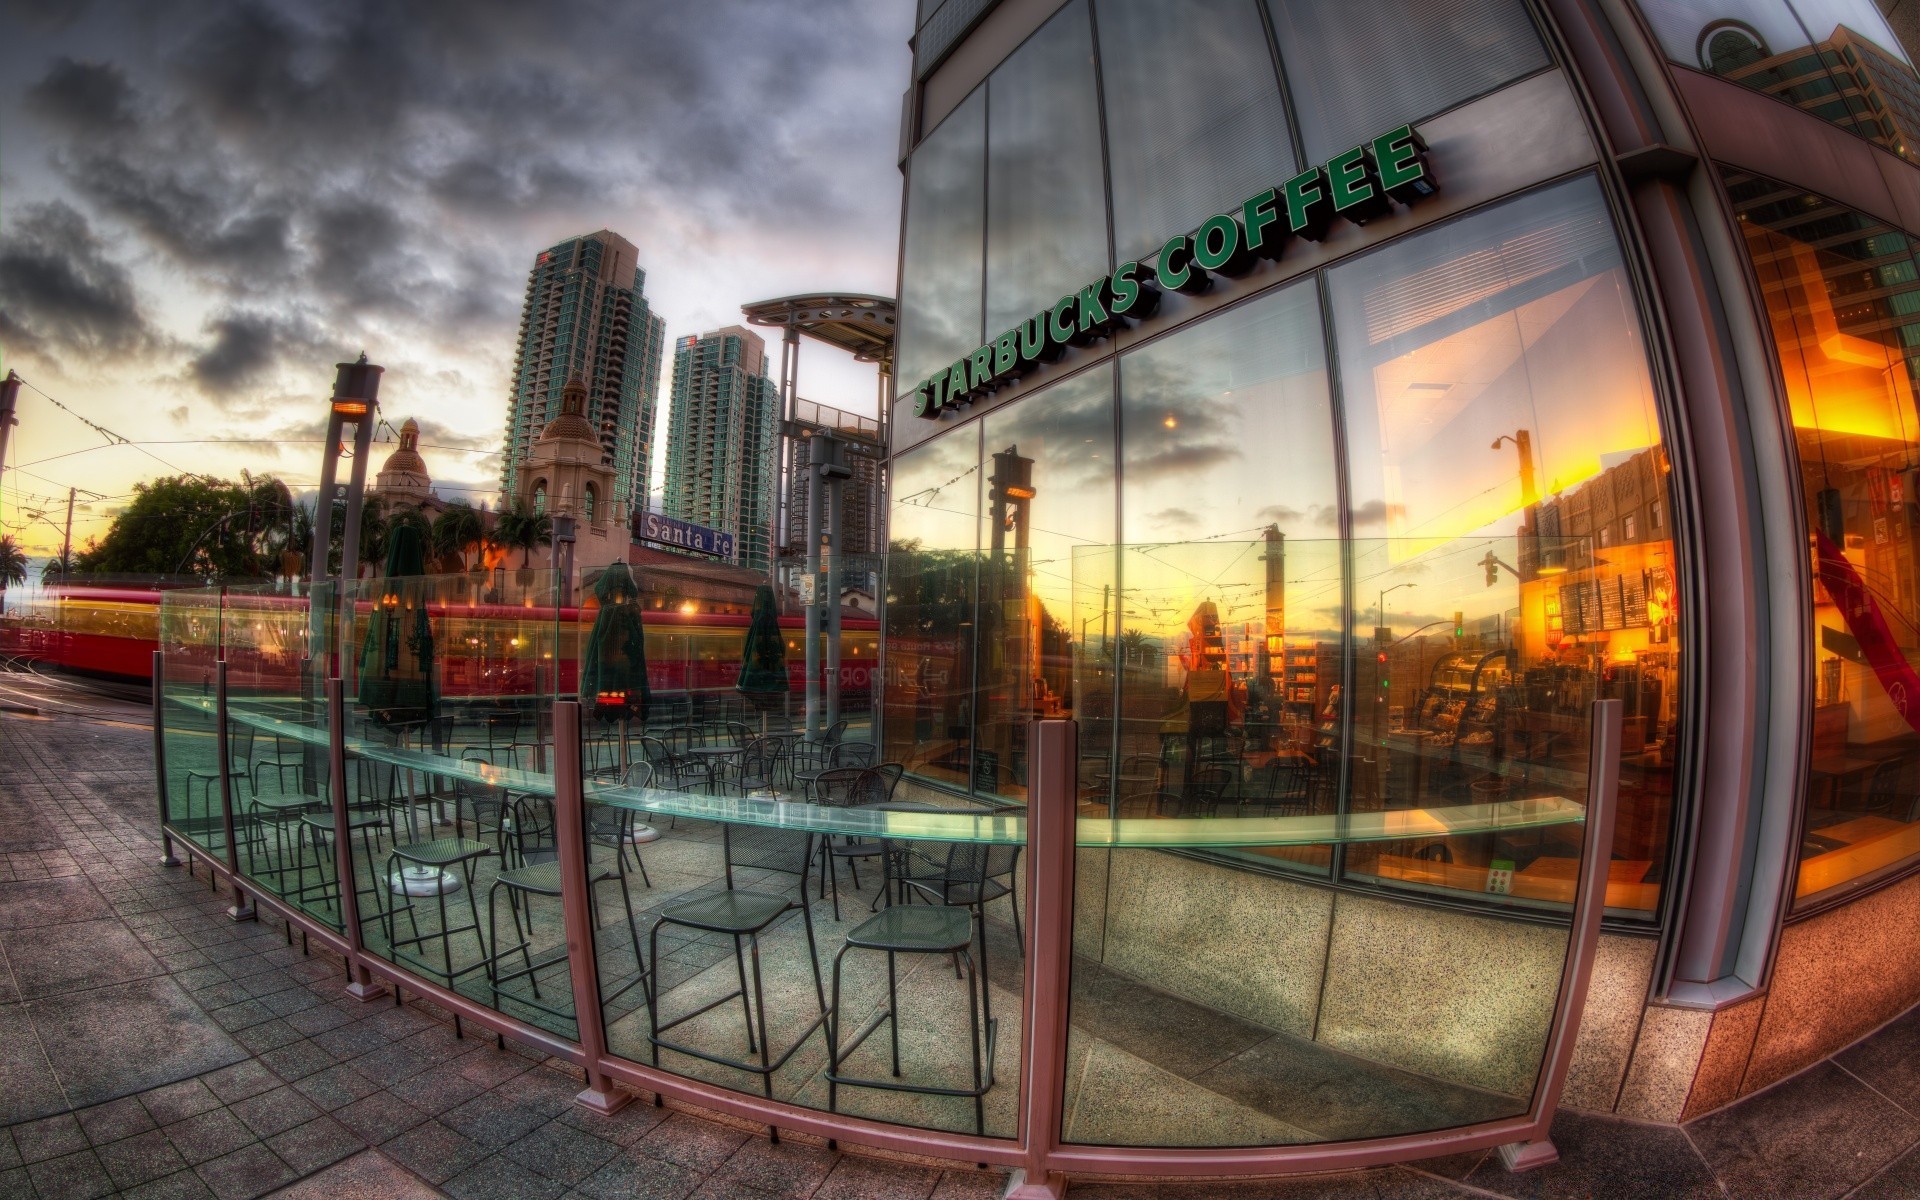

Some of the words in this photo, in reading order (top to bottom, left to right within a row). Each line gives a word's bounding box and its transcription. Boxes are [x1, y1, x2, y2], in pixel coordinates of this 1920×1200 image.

[912, 260, 1142, 418] STARBUCKS
[1156, 124, 1426, 291] COFFEE
[646, 514, 703, 549] Santa
[712, 531, 730, 555] Fe
